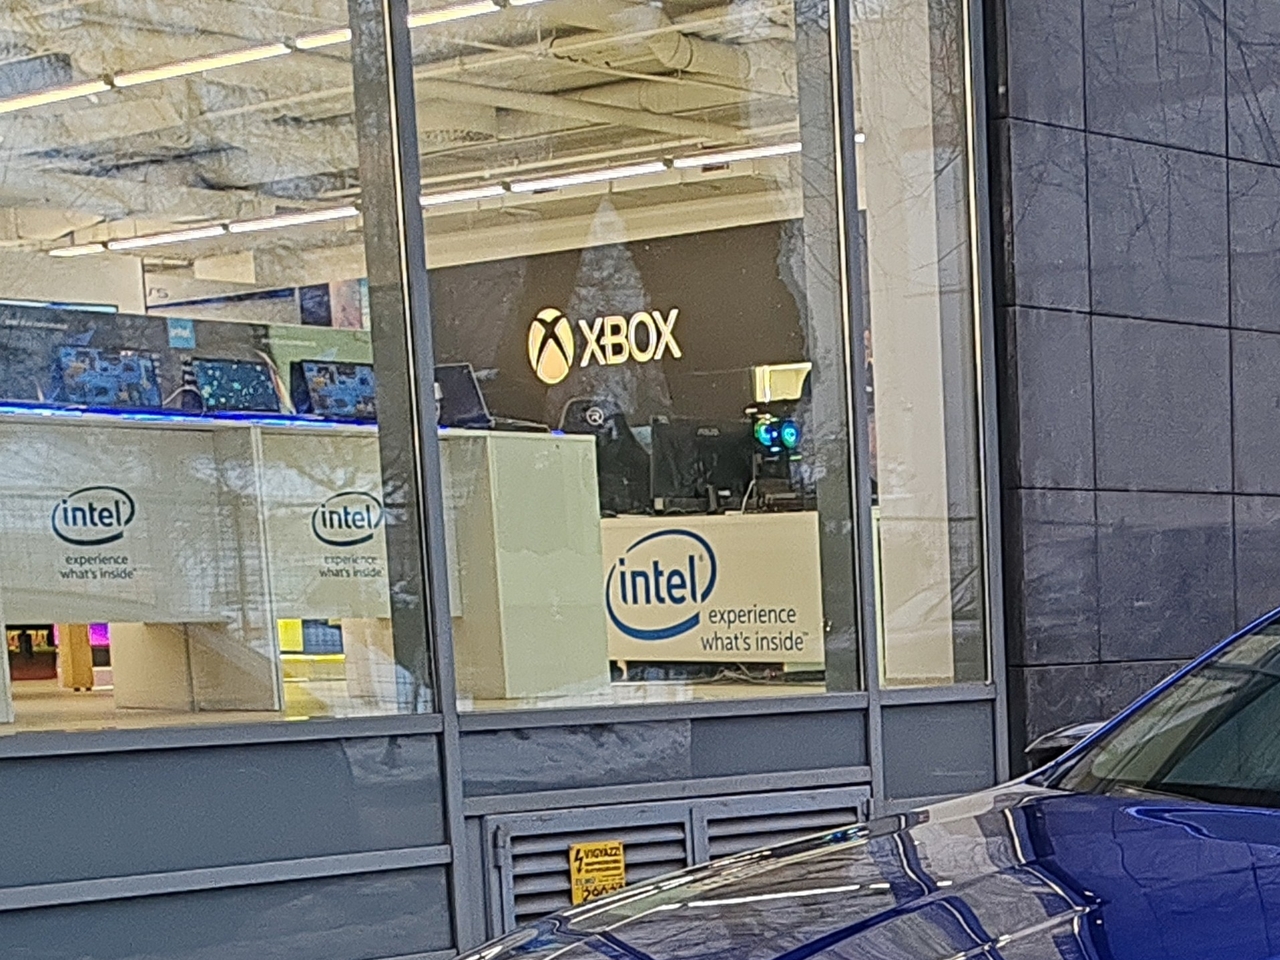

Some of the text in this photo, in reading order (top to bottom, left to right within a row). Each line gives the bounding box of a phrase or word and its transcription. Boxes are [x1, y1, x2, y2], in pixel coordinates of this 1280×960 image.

[578, 308, 682, 368] XBOX
[62, 499, 121, 527] intel
[321, 503, 373, 529] intel
[65, 552, 128, 567] experience
[60, 567, 98, 579] what's
[618, 554, 698, 605] intel
[709, 604, 797, 629] experience
[701, 631, 751, 651] what's
